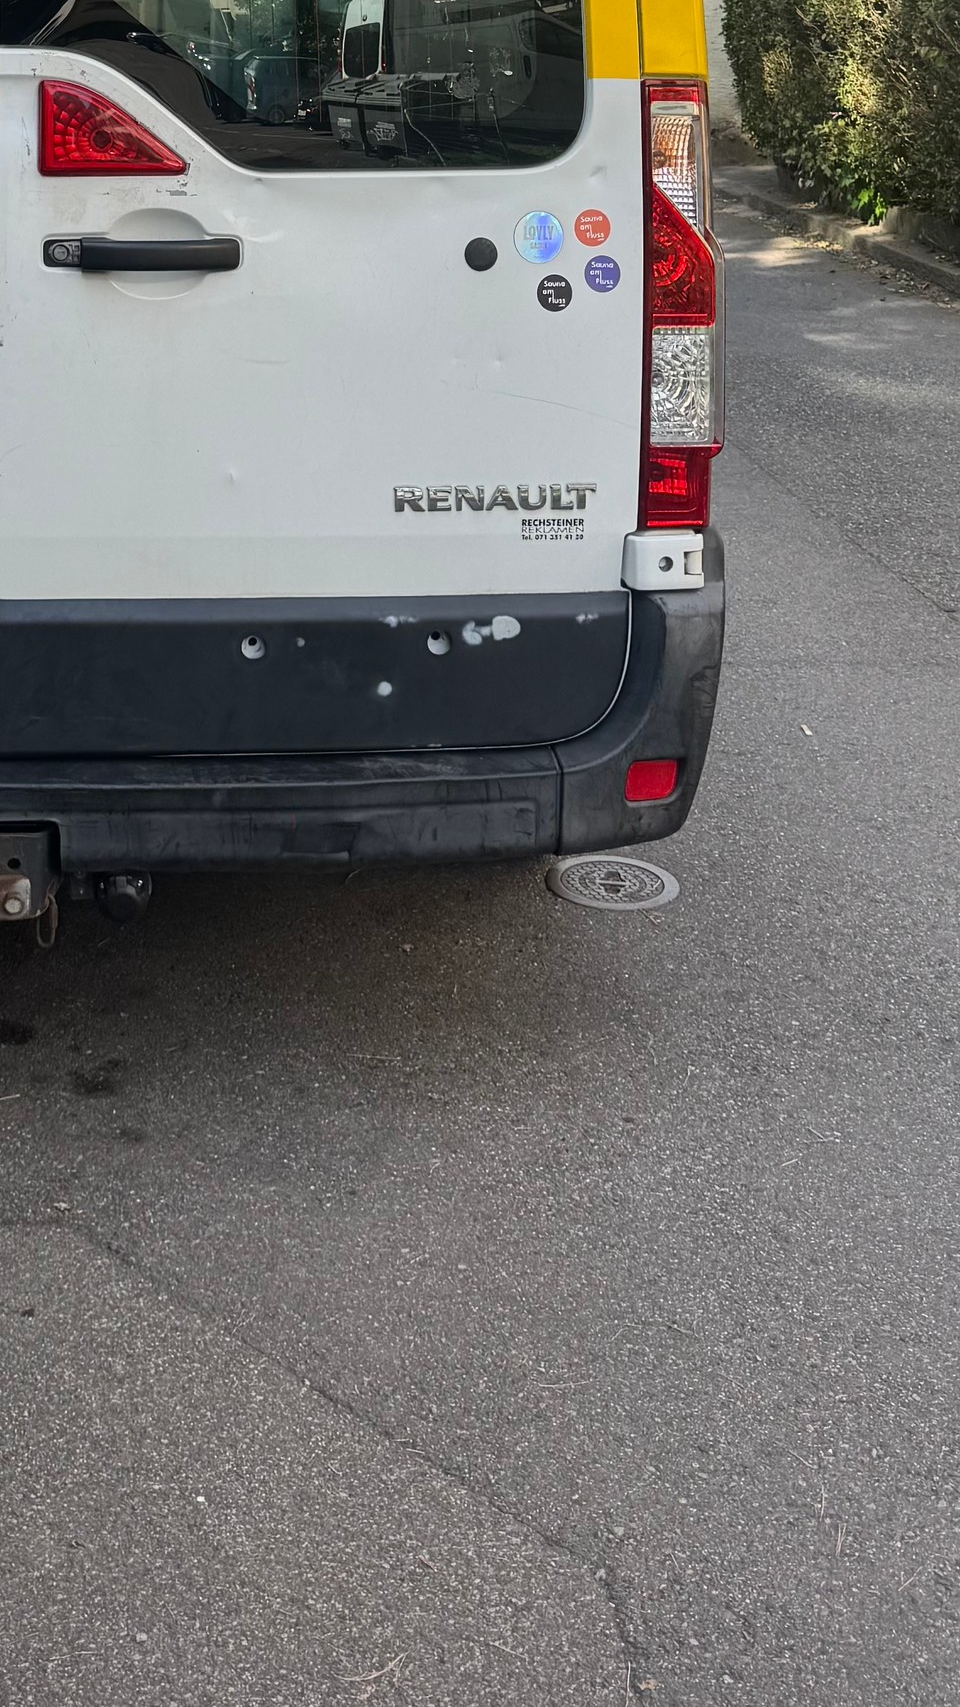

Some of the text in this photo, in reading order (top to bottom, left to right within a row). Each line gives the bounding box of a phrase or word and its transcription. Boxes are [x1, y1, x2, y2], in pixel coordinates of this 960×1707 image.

[591, 261, 614, 269] Sauna
[543, 280, 566, 288] Sauna
[393, 483, 597, 512] RENAULT
[521, 518, 584, 526] RECHSTEINER
